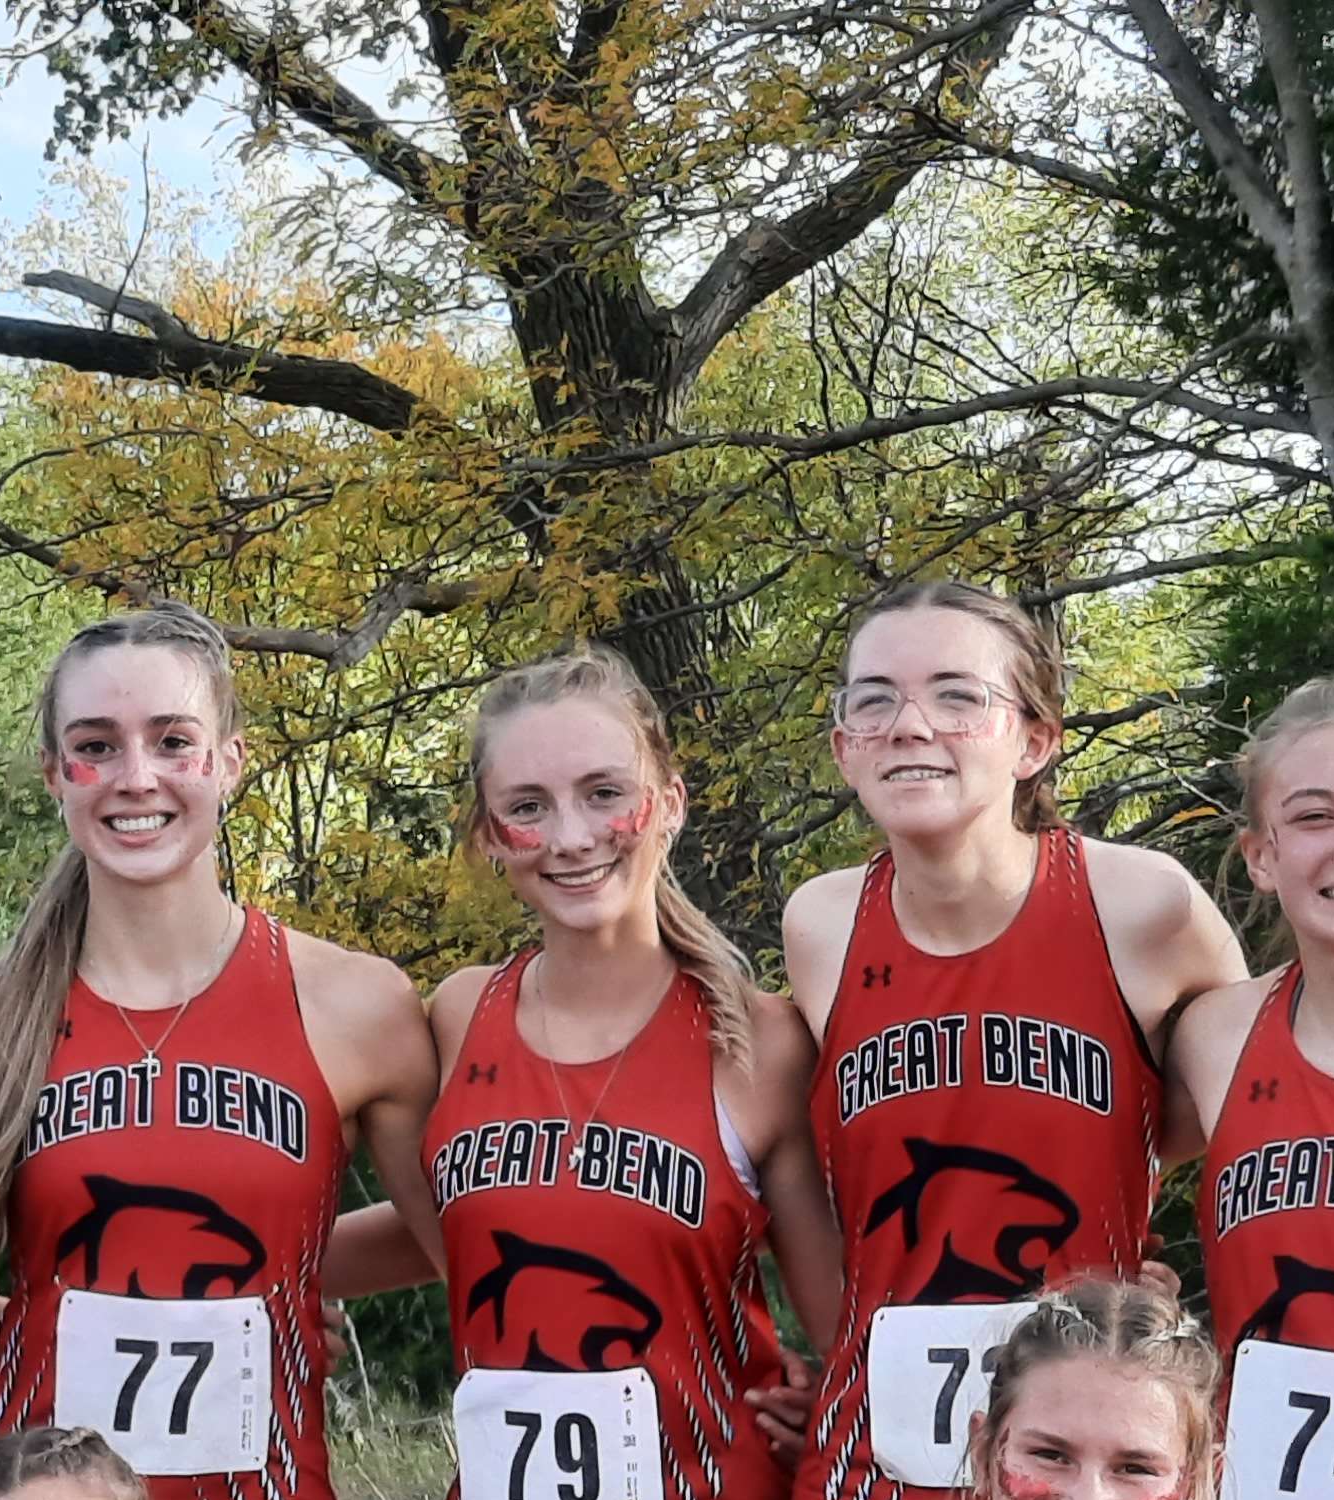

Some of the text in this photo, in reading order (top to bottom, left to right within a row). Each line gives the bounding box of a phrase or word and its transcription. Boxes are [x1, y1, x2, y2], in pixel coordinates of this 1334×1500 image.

[15, 1061, 307, 1168] REAT BEND
[835, 1013, 1112, 1126] GREAT BEND
[432, 1118, 705, 1229] GREAT BEND
[114, 1338, 214, 1435] 77
[927, 1344, 1008, 1445] 7
